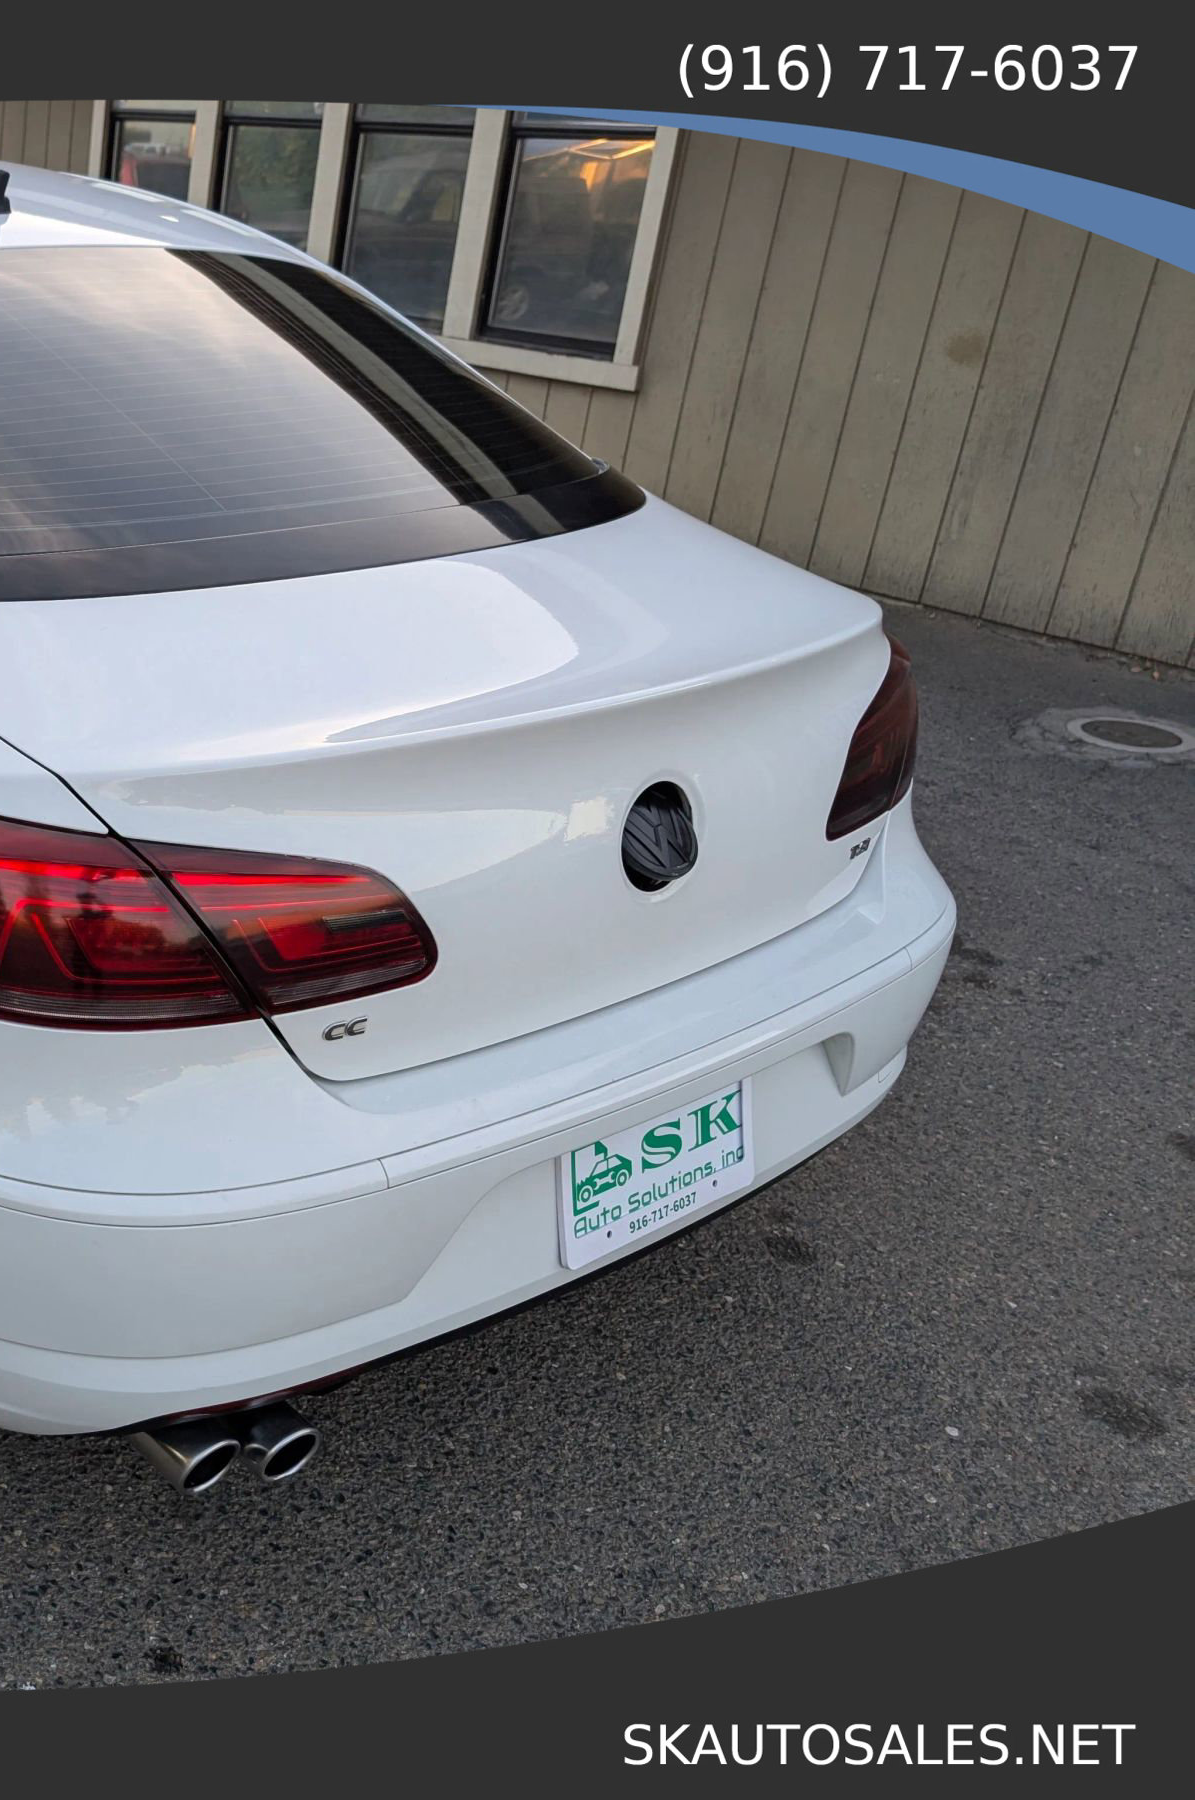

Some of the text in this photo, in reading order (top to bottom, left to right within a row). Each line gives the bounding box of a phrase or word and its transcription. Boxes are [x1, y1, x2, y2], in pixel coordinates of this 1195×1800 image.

[322, 1016, 368, 1041] CC
[641, 1089, 743, 1174] SK
[574, 1204, 622, 1239] Auto
[628, 1160, 716, 1214] Solutions,
[629, 1191, 697, 1234] 916-717-6037
